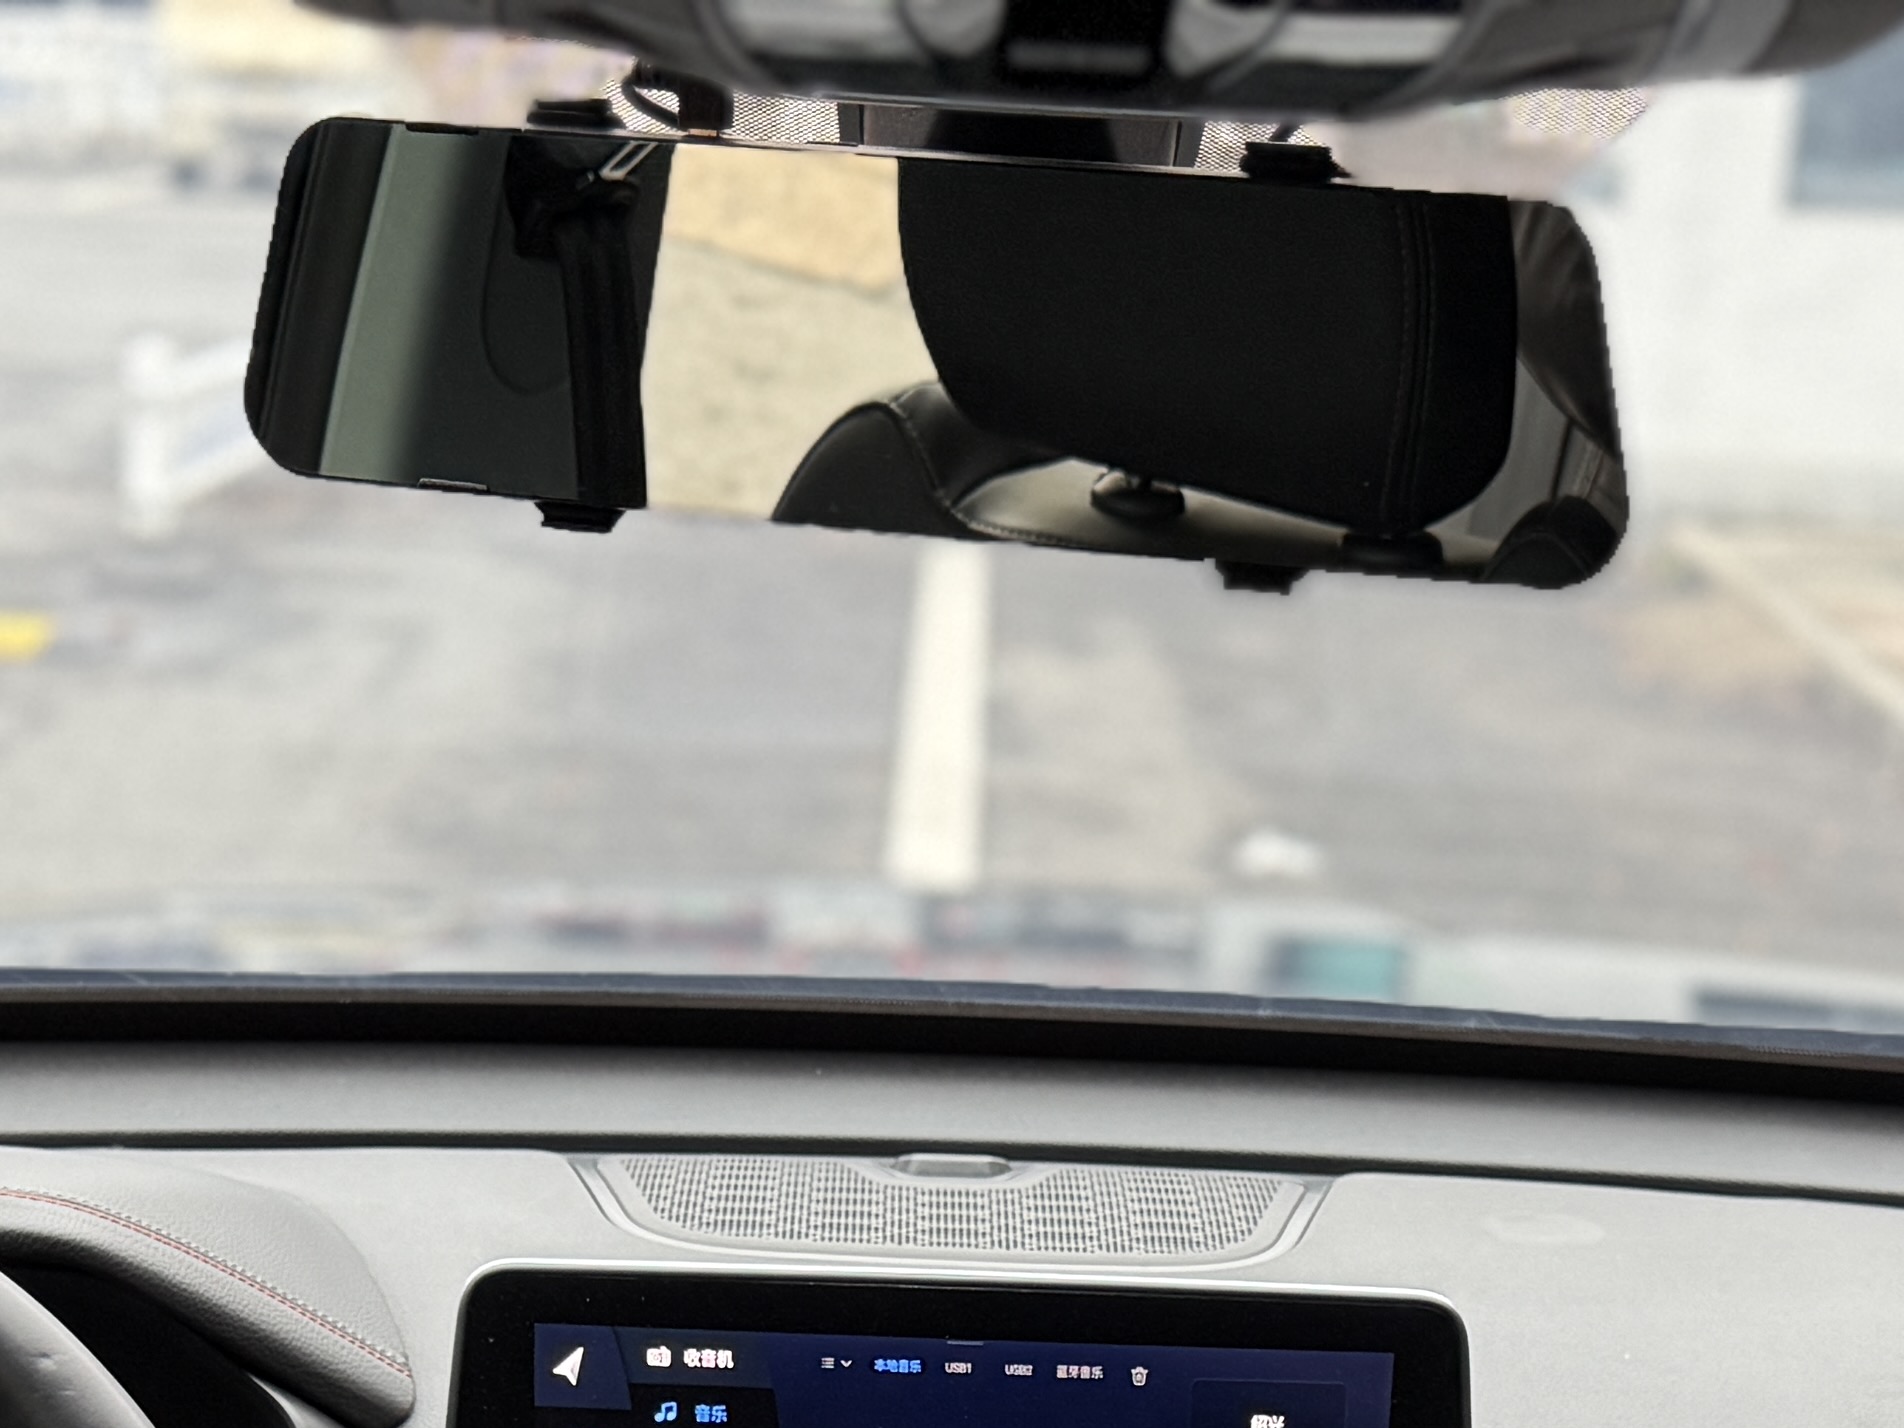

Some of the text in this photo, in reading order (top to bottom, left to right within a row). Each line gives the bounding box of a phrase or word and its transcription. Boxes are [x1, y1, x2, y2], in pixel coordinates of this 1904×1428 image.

[683, 1349, 735, 1369] 收音机
[874, 1358, 922, 1374] 本地音乐
[945, 1361, 973, 1375] USB1
[1056, 1364, 1104, 1380] 蓝牙音乐
[695, 1404, 728, 1424] 音乐
